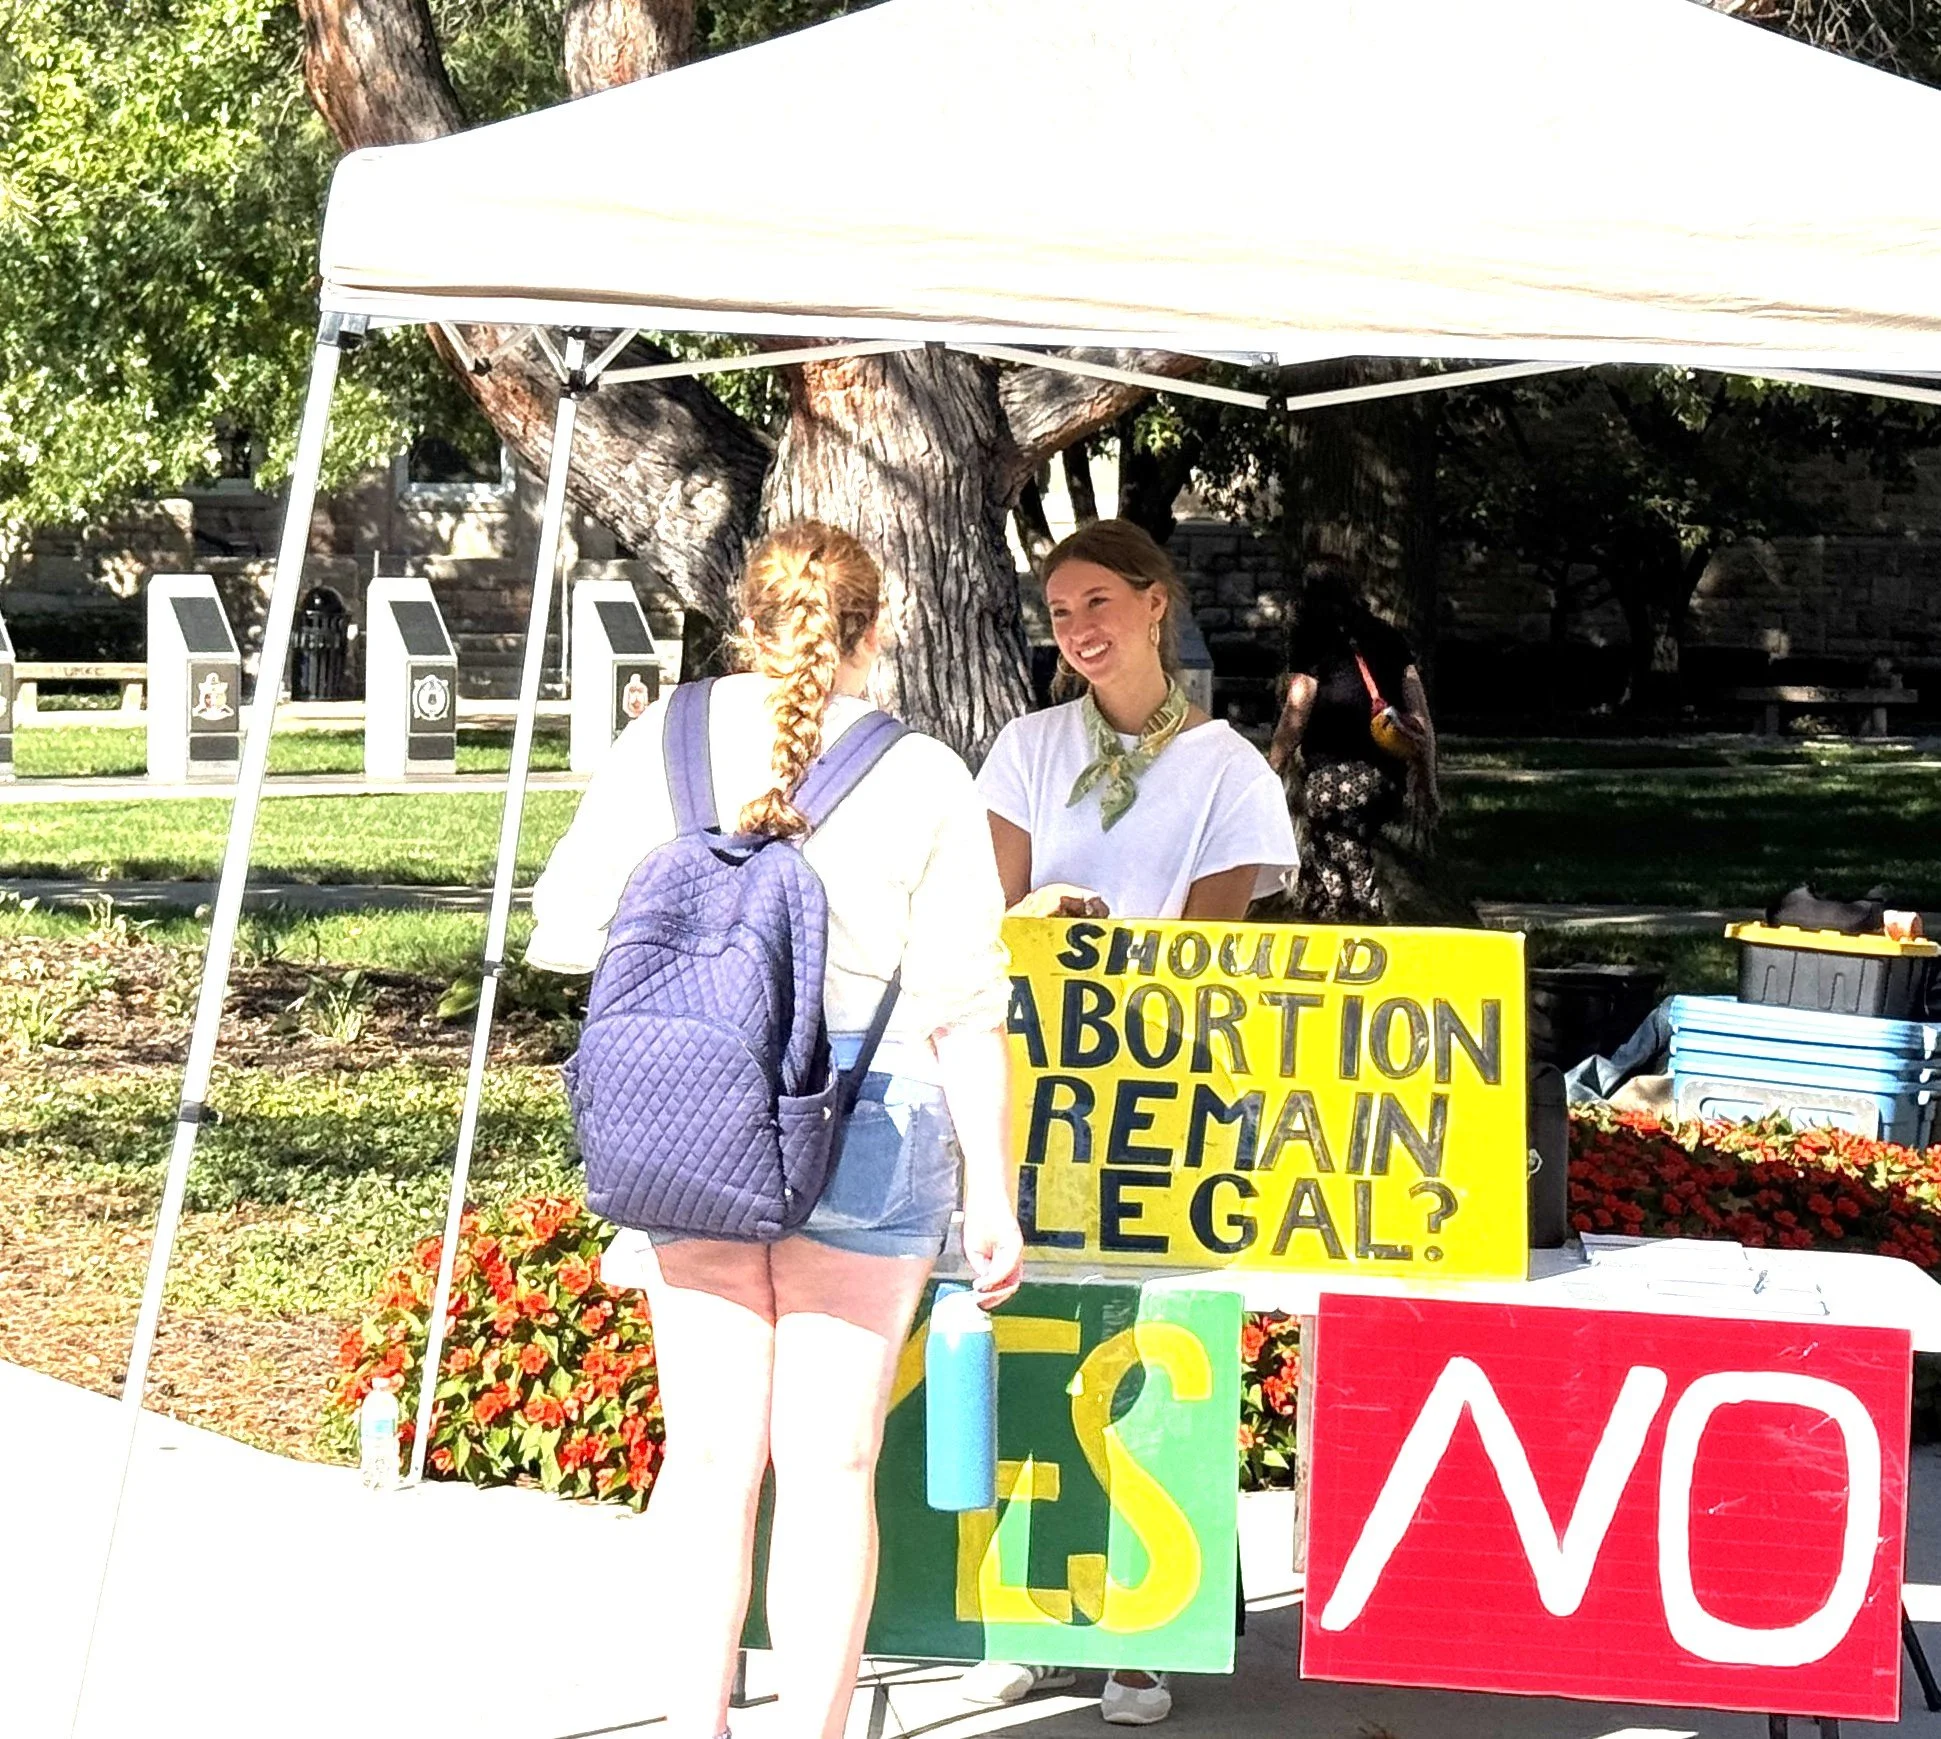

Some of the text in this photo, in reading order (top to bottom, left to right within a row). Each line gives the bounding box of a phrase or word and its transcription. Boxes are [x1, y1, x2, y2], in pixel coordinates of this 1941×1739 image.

[1057, 922, 1388, 984] SHOULD
[1007, 975, 1502, 1086] ABORTION
[1025, 1076, 1449, 1178] REMAIN
[1016, 1165, 1459, 1262] LEGAL?
[1320, 1355, 1882, 1667] NO
